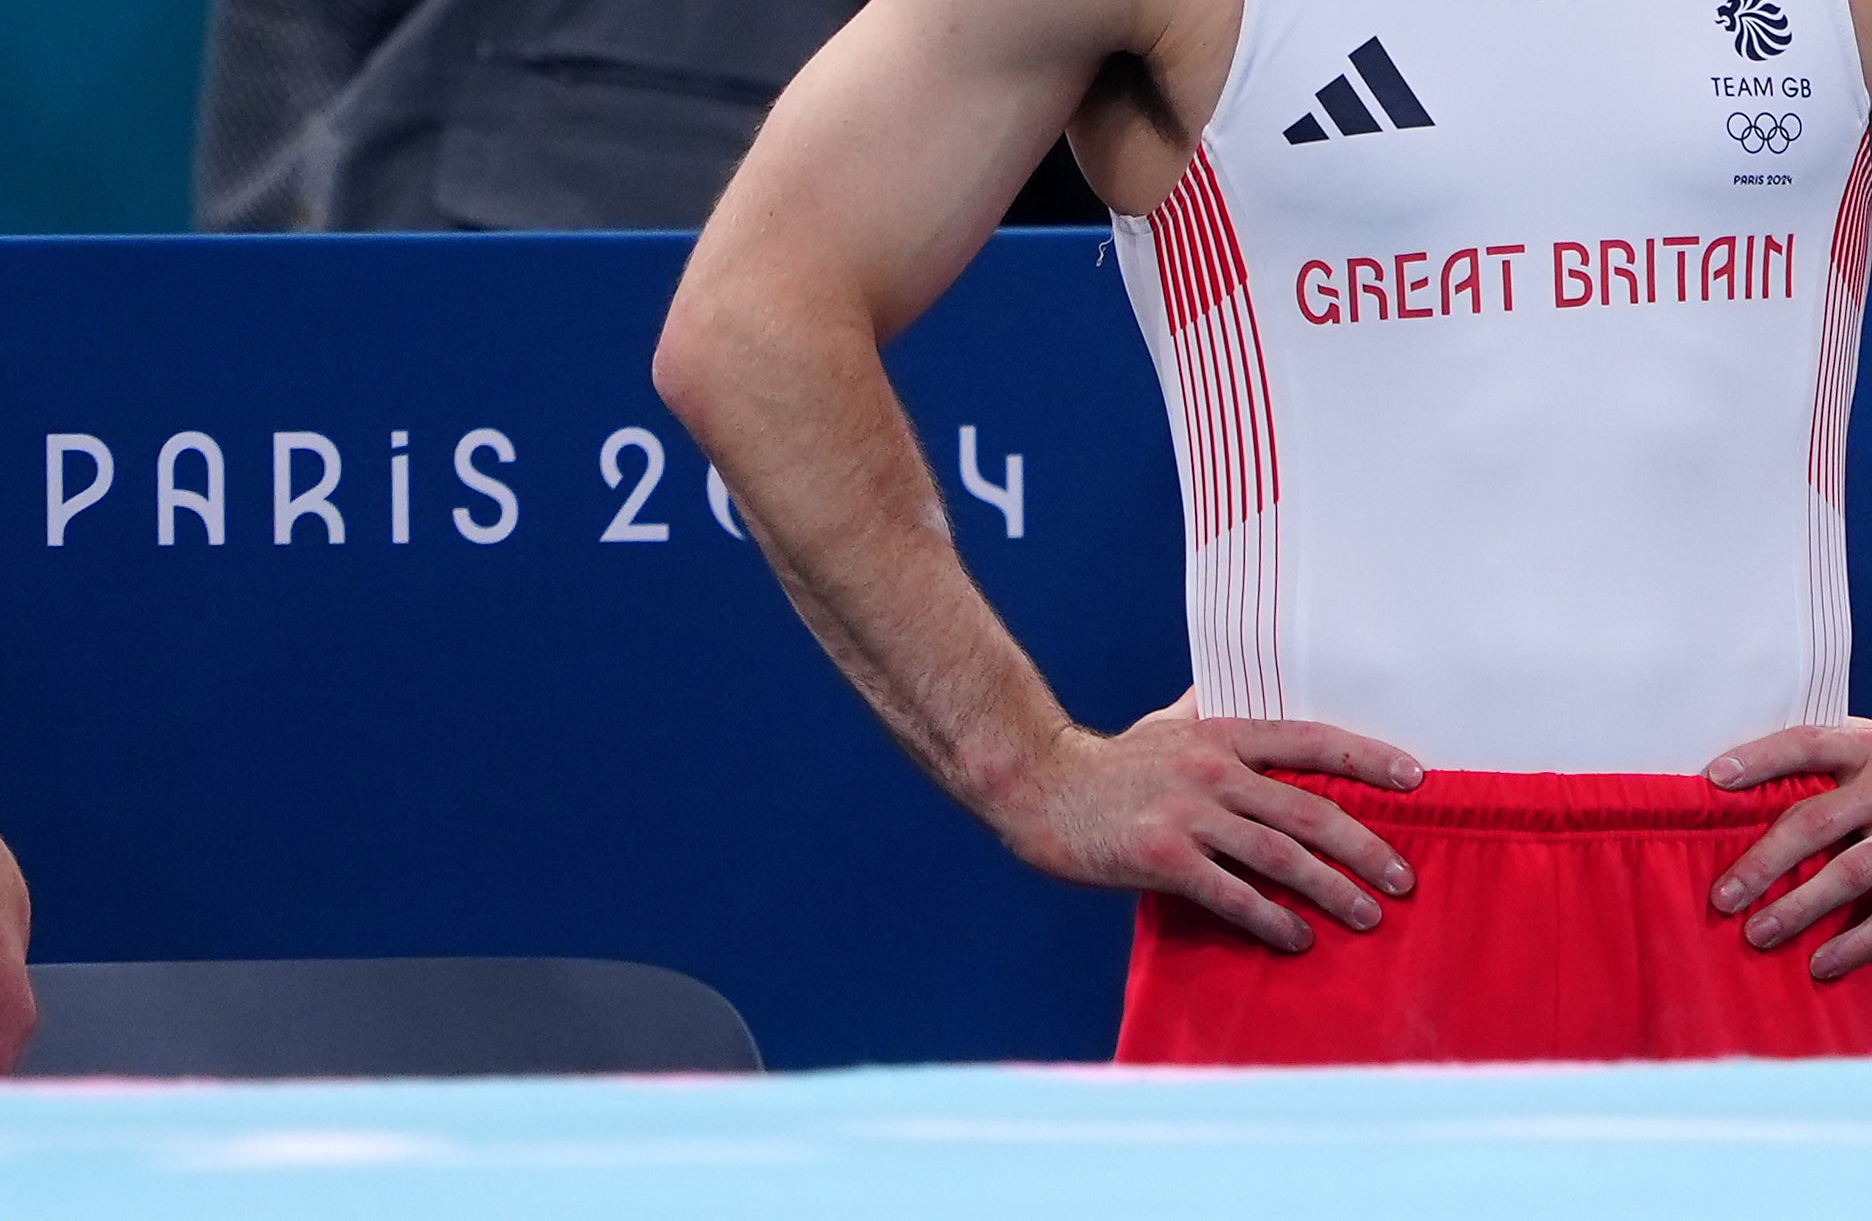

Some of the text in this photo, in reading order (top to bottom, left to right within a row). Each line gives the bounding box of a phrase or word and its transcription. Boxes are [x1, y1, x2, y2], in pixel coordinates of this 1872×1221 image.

[1711, 77, 1812, 98] TEAM GB
[1733, 174, 1793, 185] PARIS 2024
[1296, 233, 1794, 325] GREAT BRITAIN
